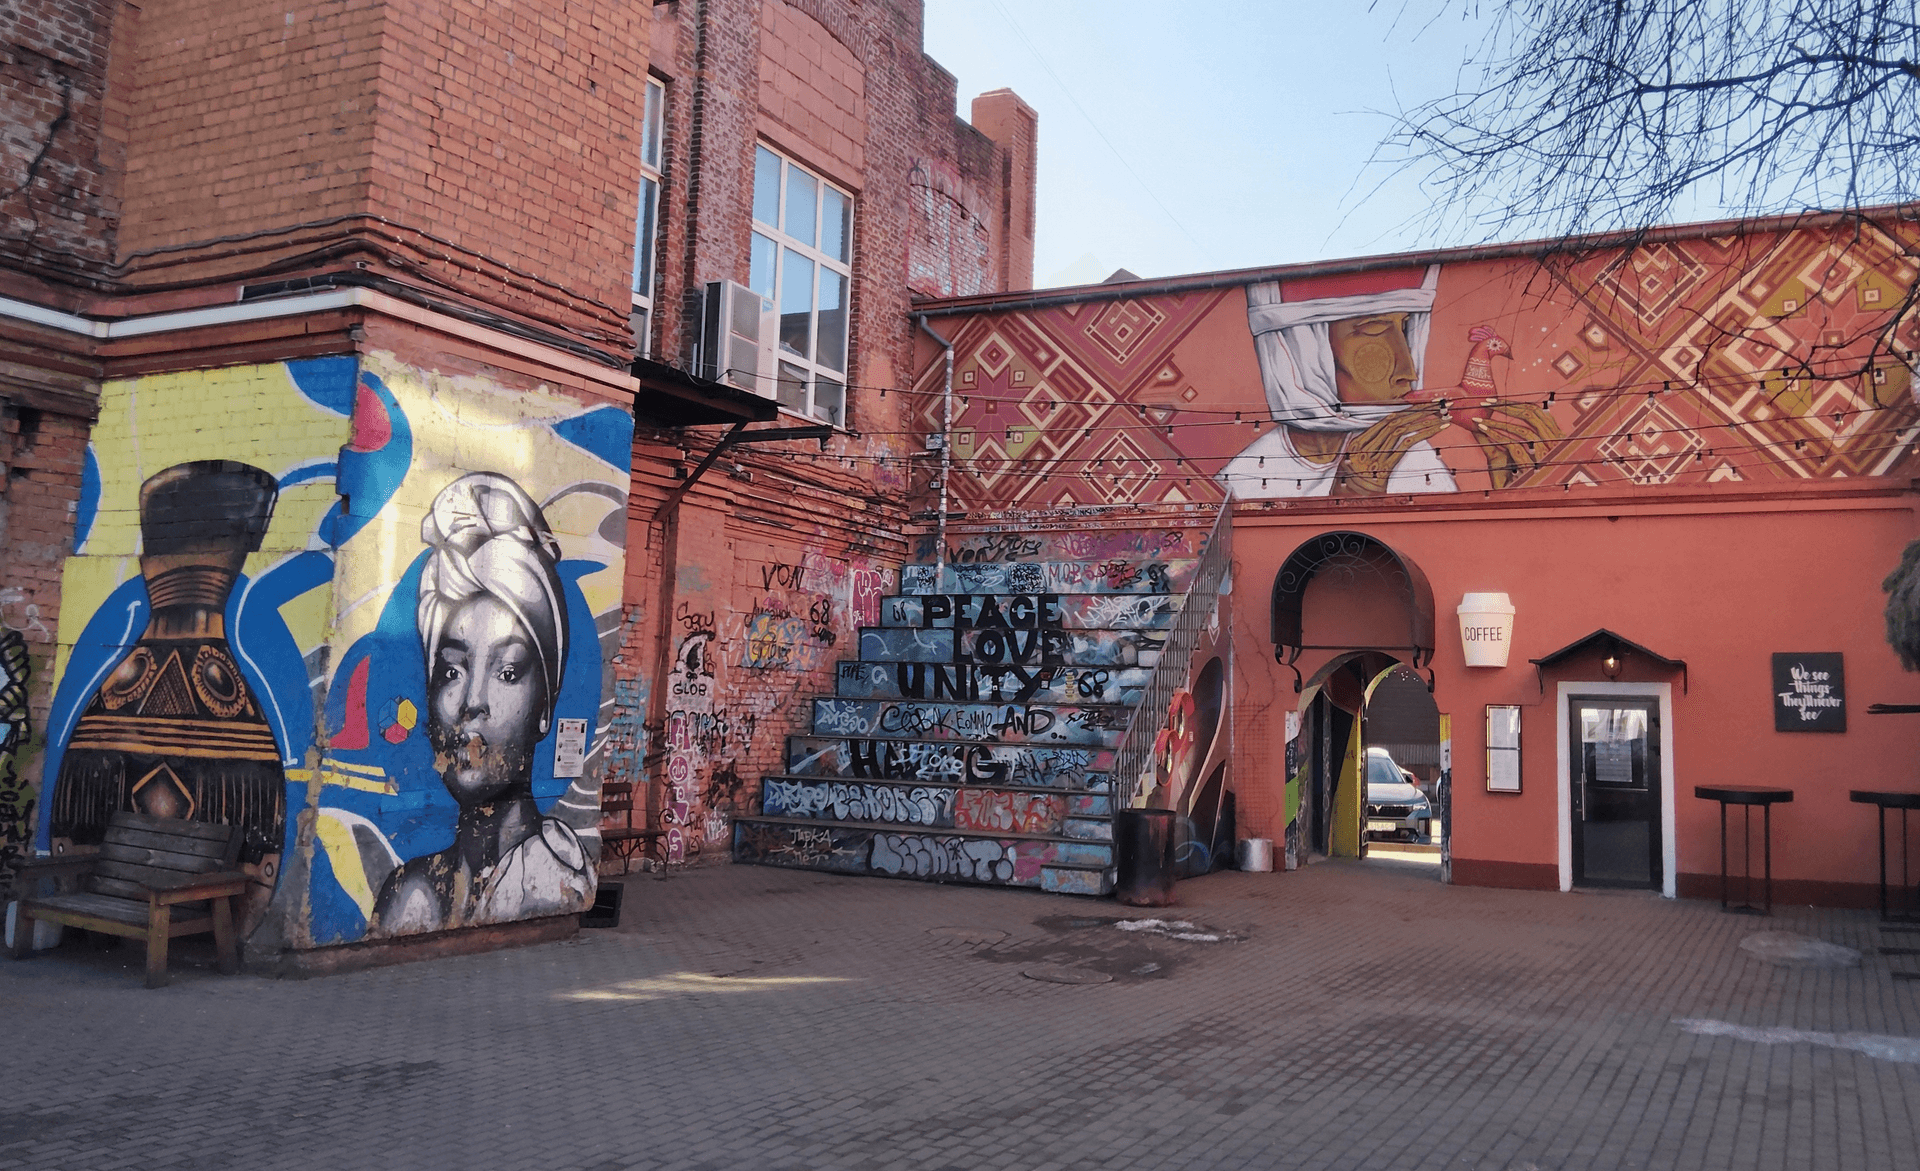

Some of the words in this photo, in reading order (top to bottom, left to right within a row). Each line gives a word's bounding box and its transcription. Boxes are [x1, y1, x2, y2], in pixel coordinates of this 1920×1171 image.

[809, 598, 830, 625] 68
[922, 595, 1063, 629] PEACE
[1464, 626, 1503, 641] COFFEE
[952, 628, 1067, 665] LOVE
[898, 662, 1058, 702] UNITY
[1078, 668, 1109, 698] 68
[1790, 662, 1811, 680] We
[1812, 671, 1831, 681] see
[1787, 680, 1834, 698] things
[1813, 696, 1842, 708] never
[1800, 710, 1822, 721] see
